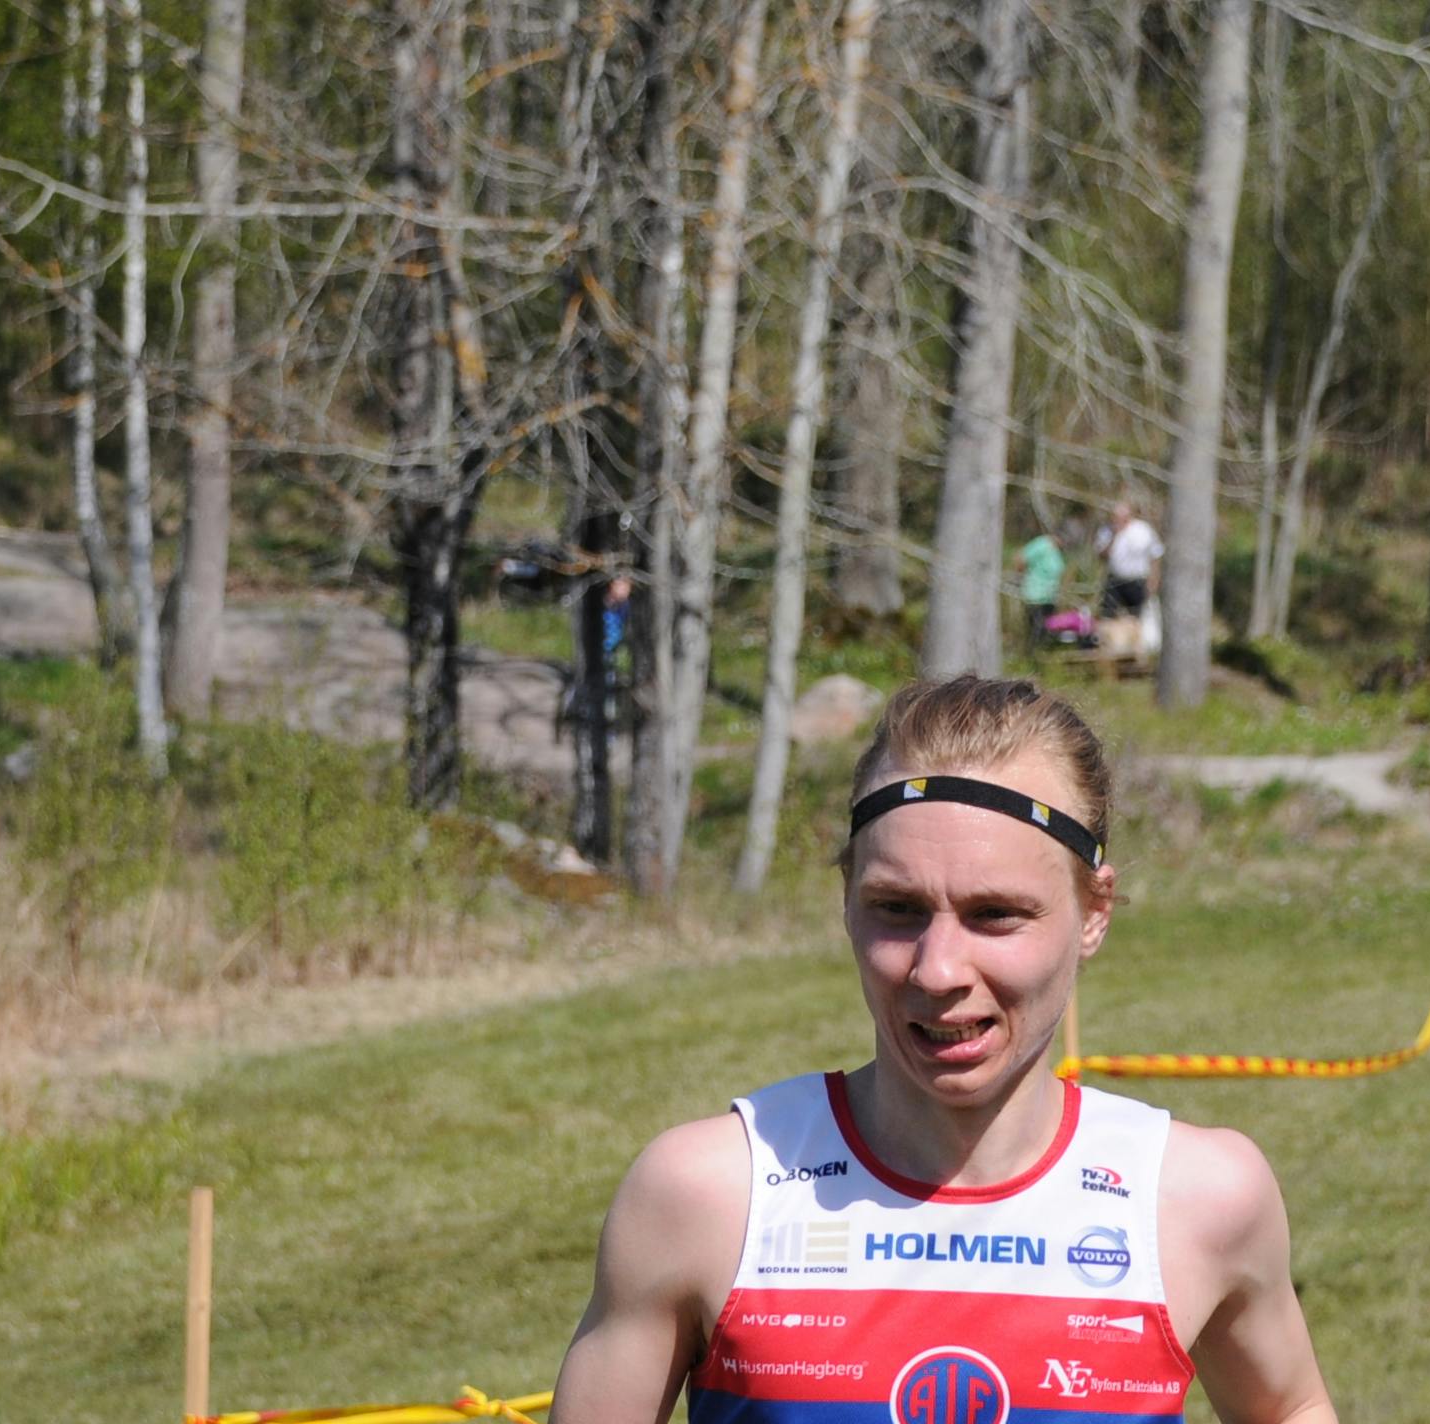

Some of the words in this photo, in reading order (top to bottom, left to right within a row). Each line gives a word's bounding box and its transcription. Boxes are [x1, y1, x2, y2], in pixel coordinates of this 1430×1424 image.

[1081, 1181, 1131, 1199] teknik
[865, 1232, 1046, 1266] HOLMEN
[1071, 1249, 1128, 1264] VOLVO
[757, 1266, 800, 1274] MODERN
[804, 1266, 848, 1274] EKONOMI
[742, 1313, 781, 1326] MVG
[802, 1314, 847, 1328] BUD
[1067, 1313, 1108, 1328] sport
[739, 1359, 865, 1381] HusmanHagberg
[1165, 1380, 1181, 1395] AB
